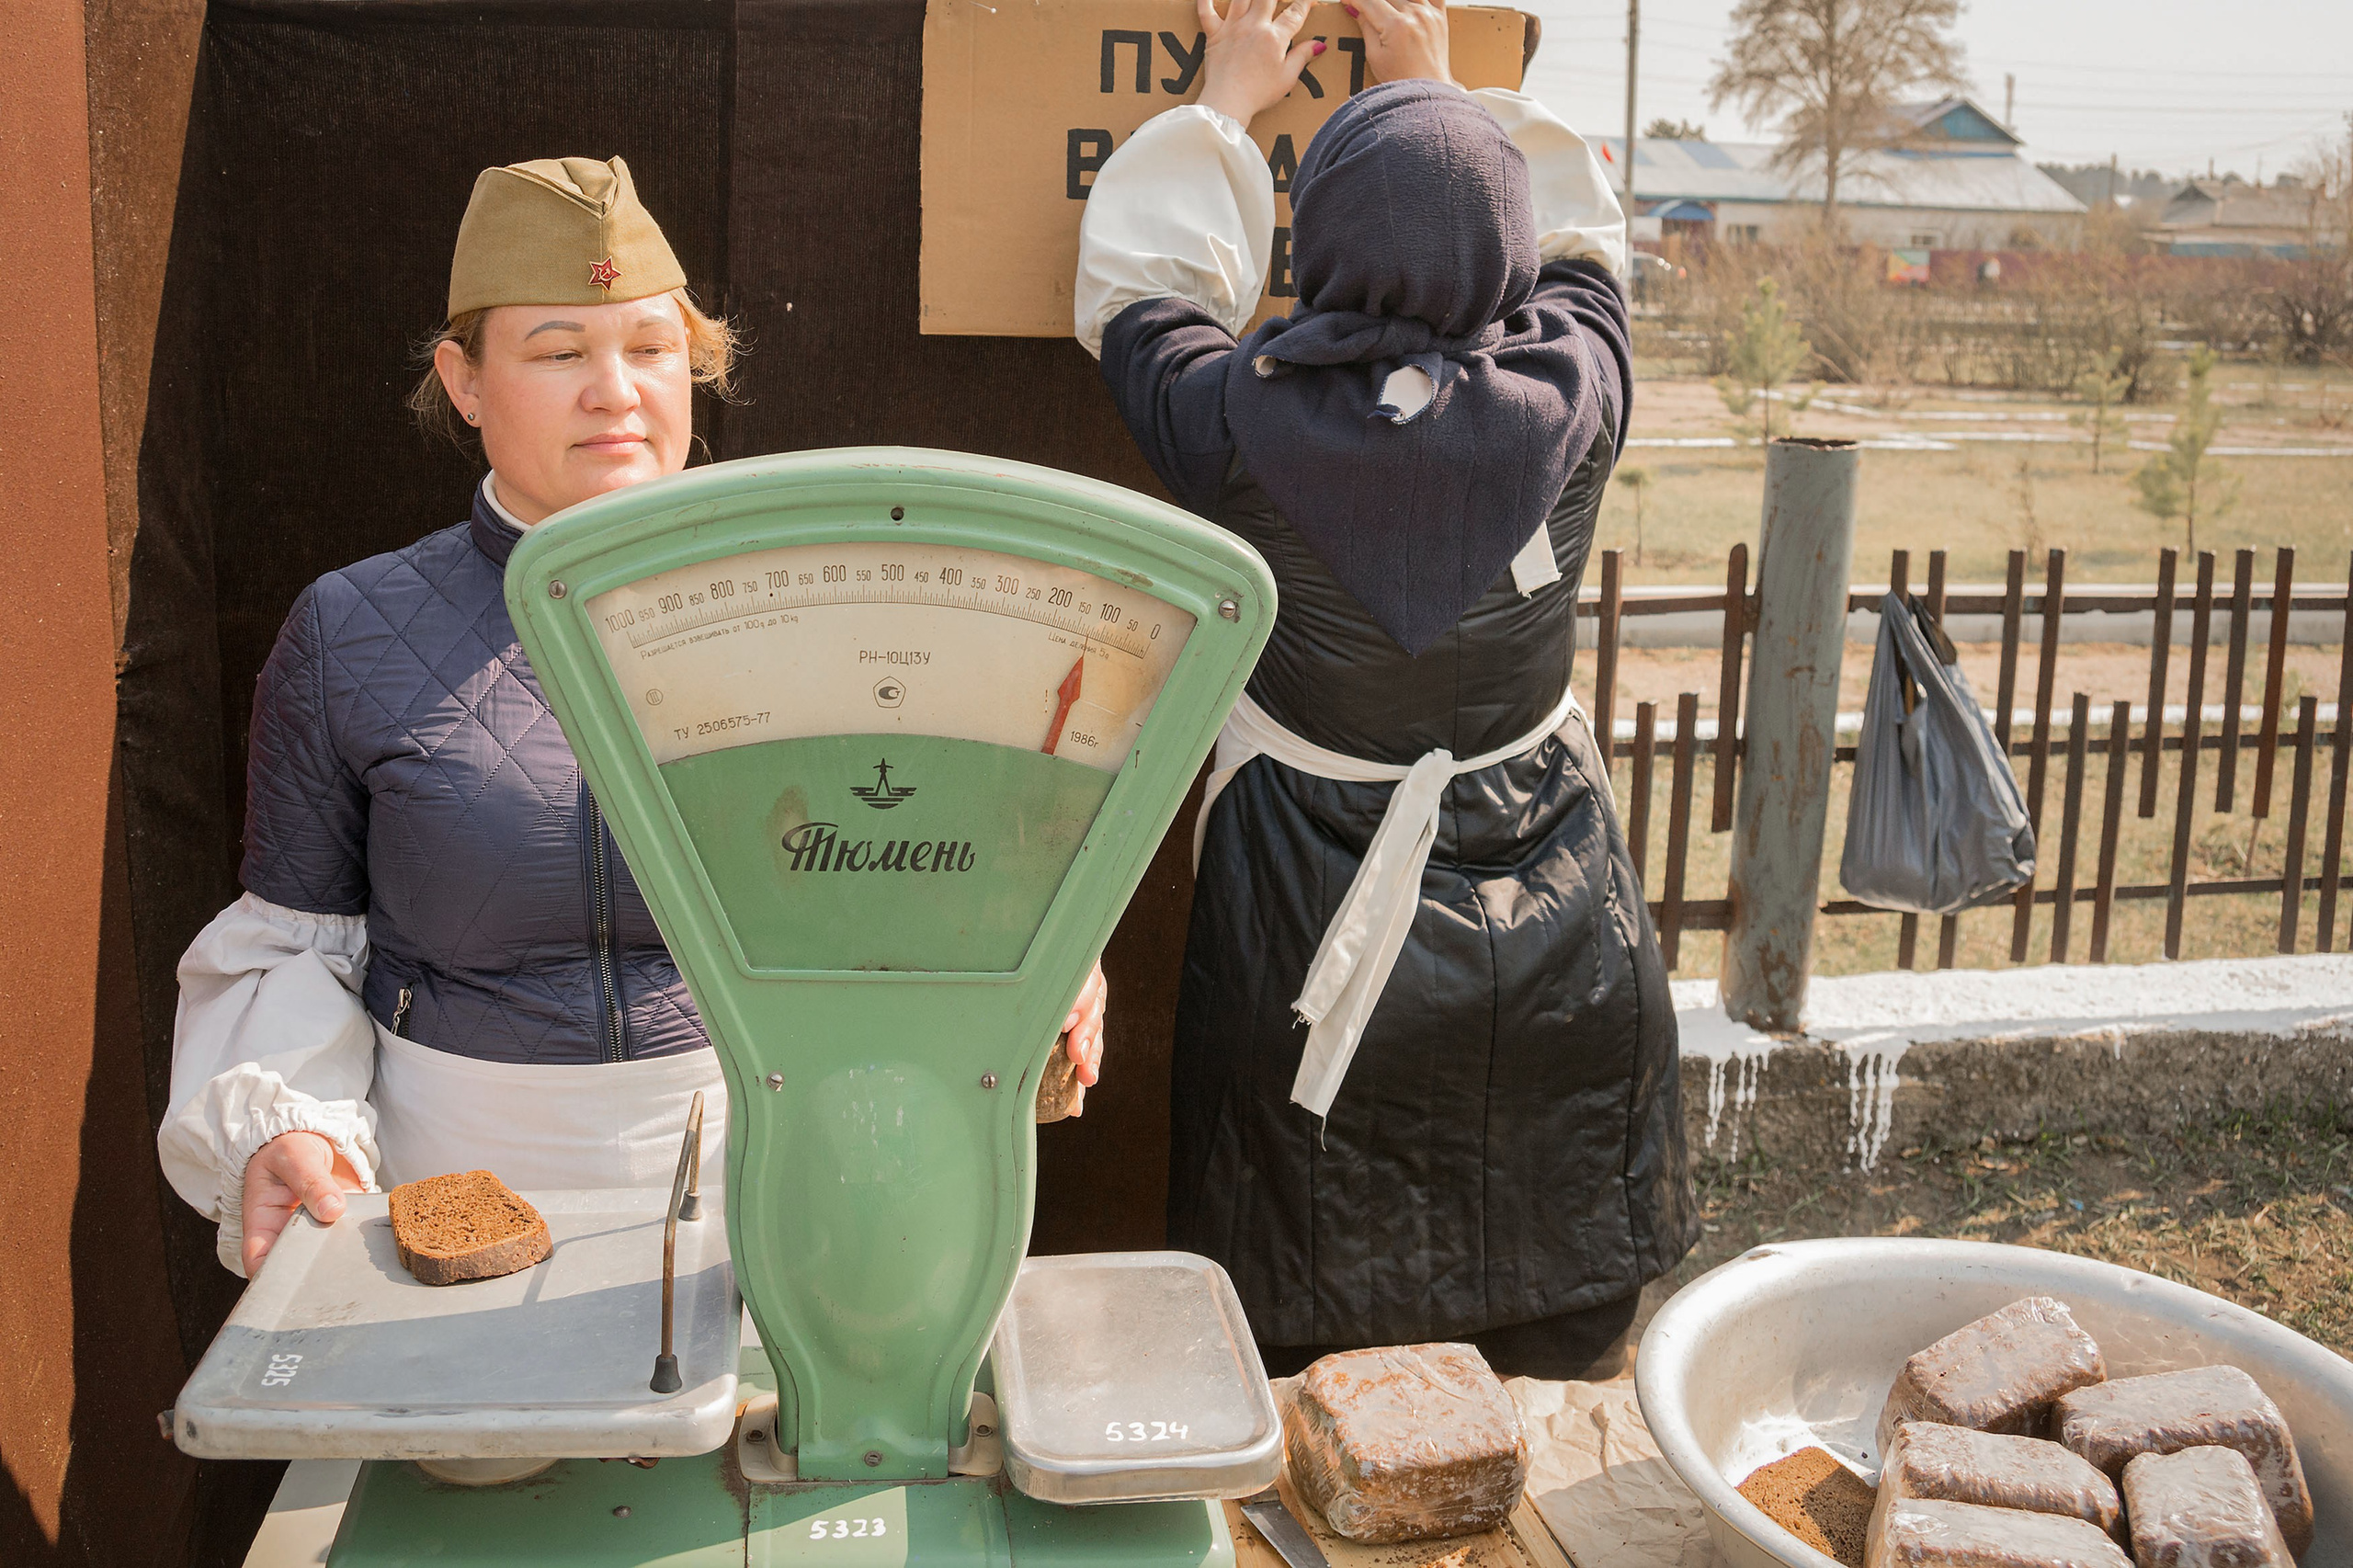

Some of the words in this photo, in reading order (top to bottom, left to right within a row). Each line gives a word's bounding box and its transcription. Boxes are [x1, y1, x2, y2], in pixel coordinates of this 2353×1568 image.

[1100, 29, 1366, 98] ПУКТ
[605, 608, 635, 633] 1000
[638, 608, 655, 621] 950
[658, 593, 684, 614] 900
[688, 592, 705, 606] 850
[710, 579, 735, 600] 800
[743, 580, 758, 594] 750
[765, 570, 790, 589] 700
[798, 573, 814, 585] 650
[823, 564, 847, 583] 600
[856, 570, 871, 582] 550
[881, 563, 904, 582] 500
[914, 571, 929, 584] 450
[938, 567, 962, 586] 400
[971, 577, 986, 590] 350
[995, 574, 1019, 595] 300
[1025, 587, 1041, 601] 250
[1048, 586, 1073, 608] 200
[1077, 601, 1092, 615] 150
[1099, 603, 1121, 624] 100
[1126, 619, 1139, 632] 50
[1150, 623, 1161, 640] 0
[859, 650, 931, 665] РН-10Ц13У
[674, 726, 689, 740] ТУ
[1070, 731, 1099, 748] 1986г
[781, 822, 976, 872] Тюмень
[1105, 1421, 1188, 1442] 5324
[809, 1517, 887, 1540] 5323
